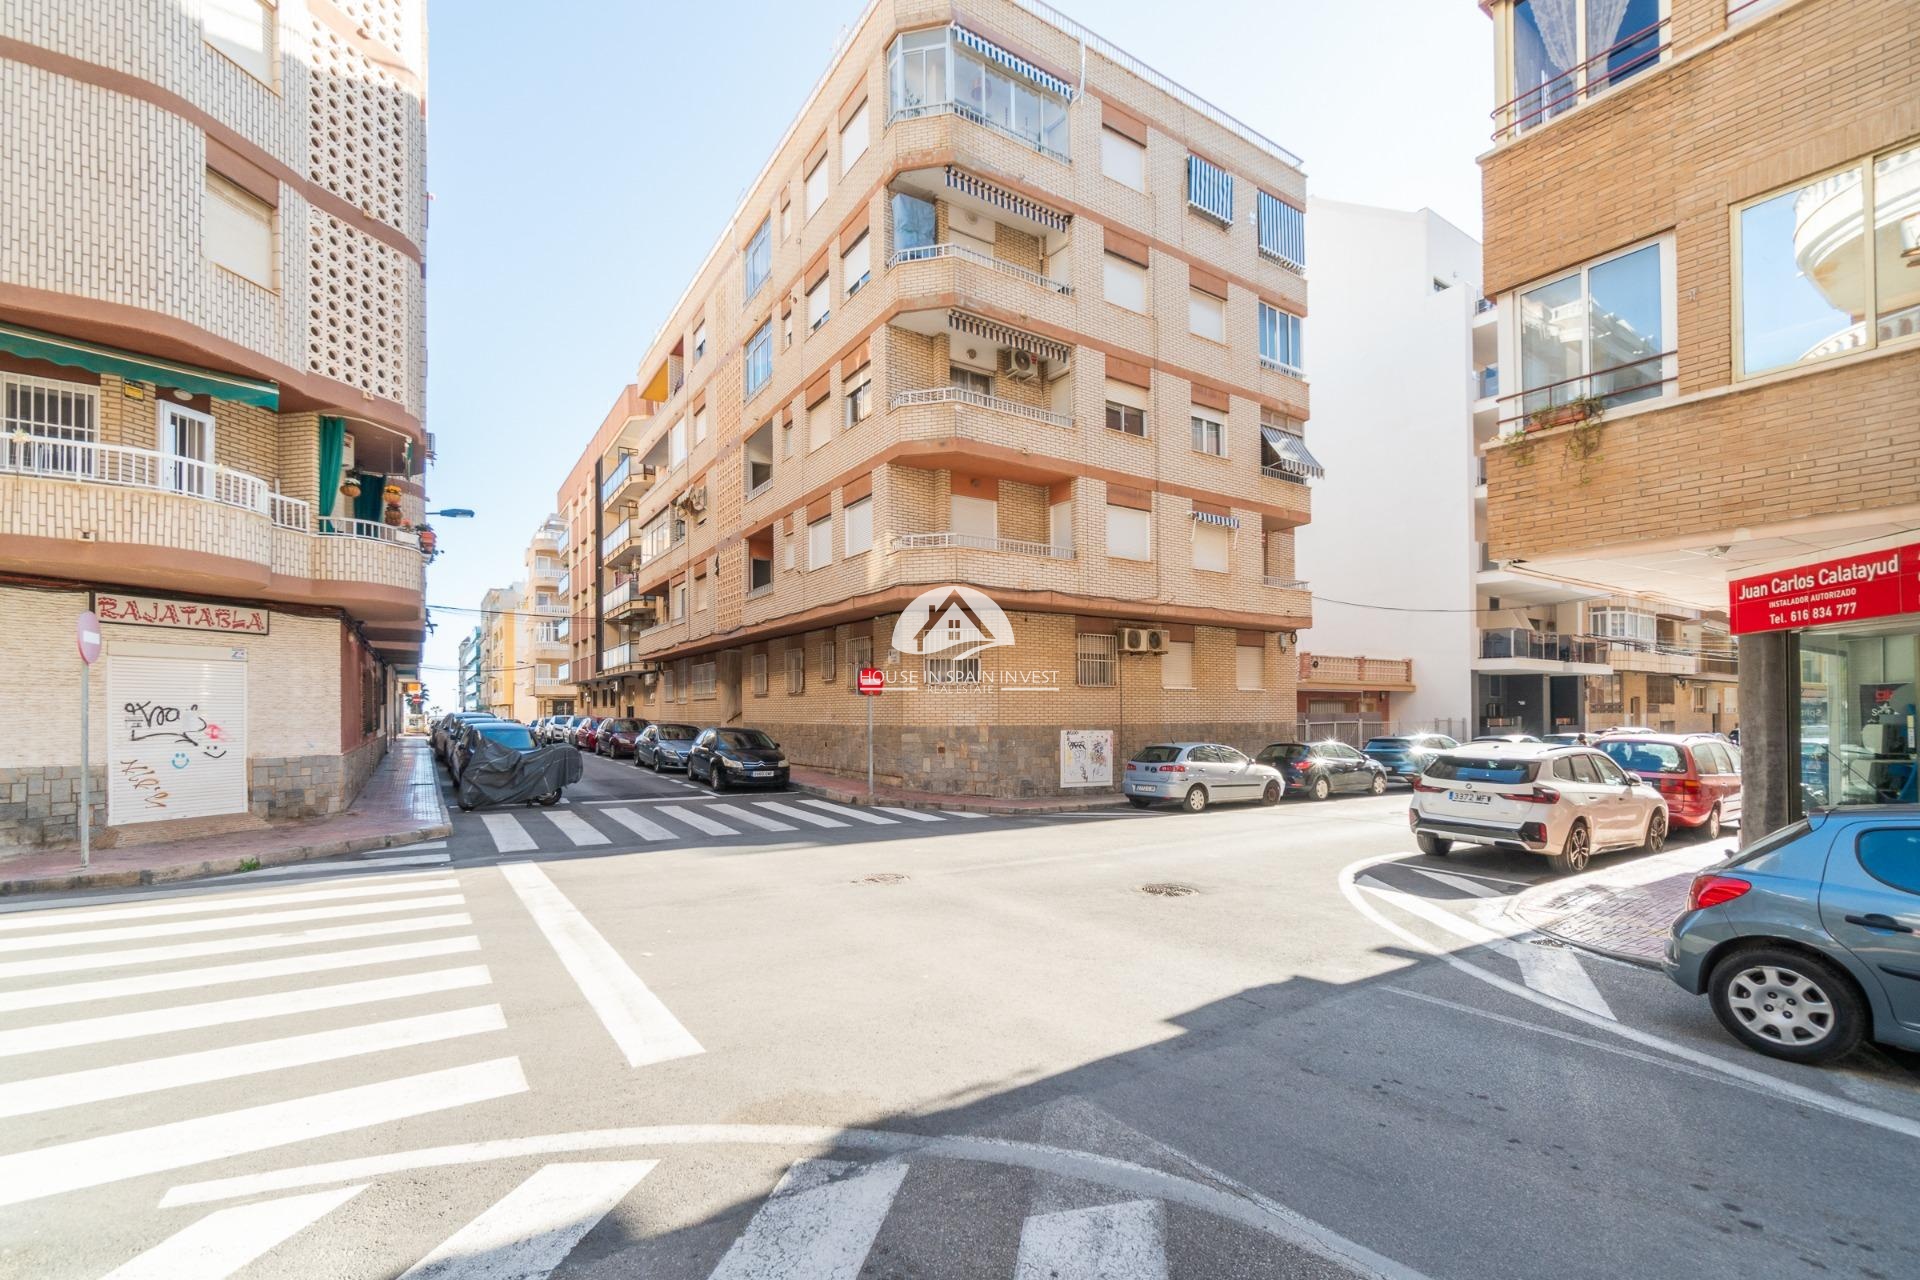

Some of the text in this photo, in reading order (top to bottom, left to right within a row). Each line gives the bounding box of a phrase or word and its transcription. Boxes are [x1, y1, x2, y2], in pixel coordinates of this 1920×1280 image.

[1739, 553, 1899, 600] Juan Carlos Calatayud
[1768, 587, 1857, 609] INSTALADOR AUTORIZADO
[97, 597, 265, 631] RAJATABLA
[1769, 602, 1857, 625] Tel. 616 834 777
